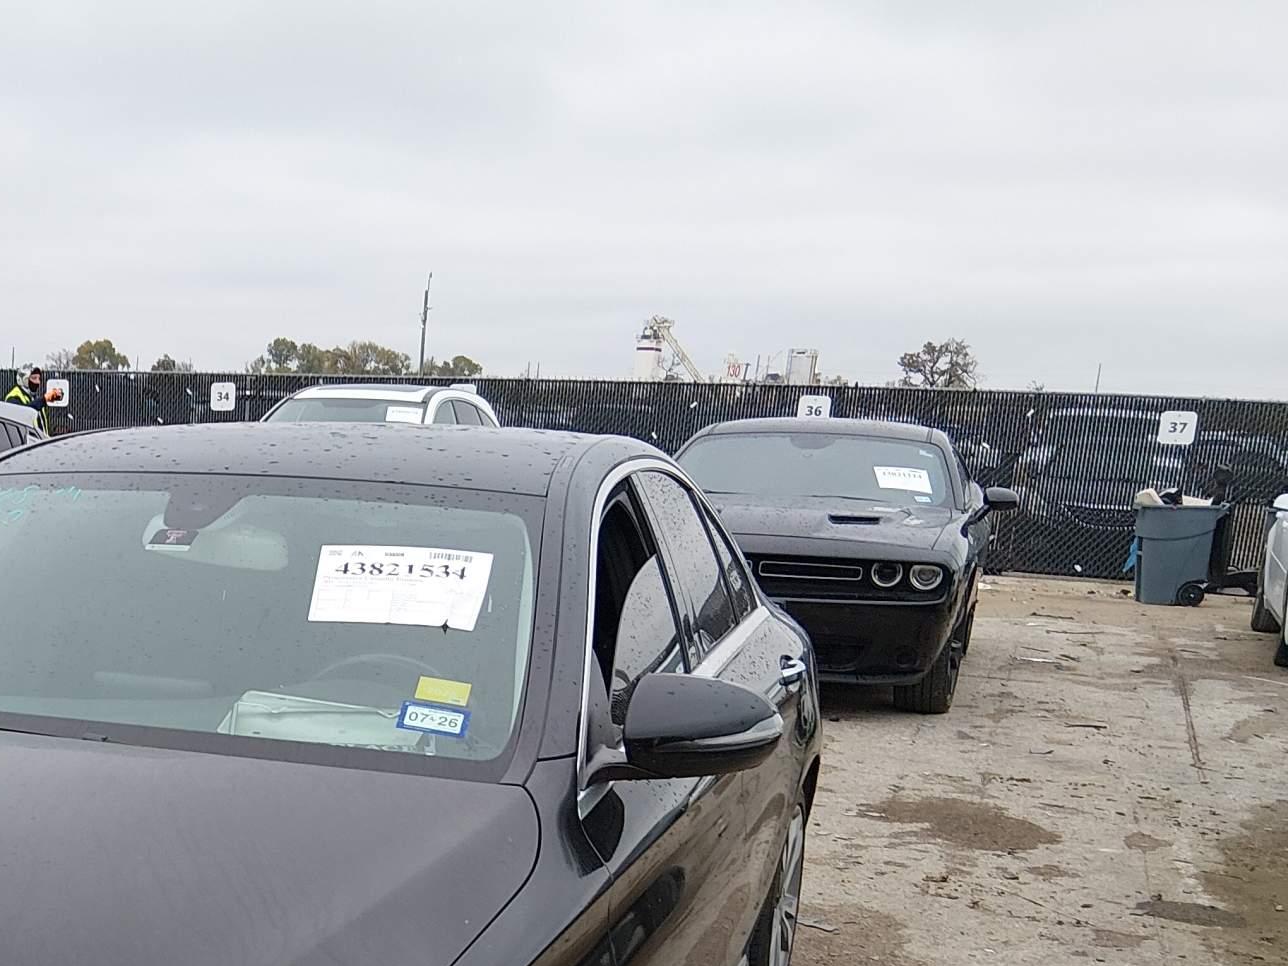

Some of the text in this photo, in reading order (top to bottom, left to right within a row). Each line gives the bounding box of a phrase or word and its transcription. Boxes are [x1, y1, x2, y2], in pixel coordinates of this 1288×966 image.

[727, 363, 741, 378] 130
[216, 391, 230, 402] 34
[805, 405, 823, 417] 36
[1168, 421, 1189, 434] 37
[335, 561, 467, 580] 43821534
